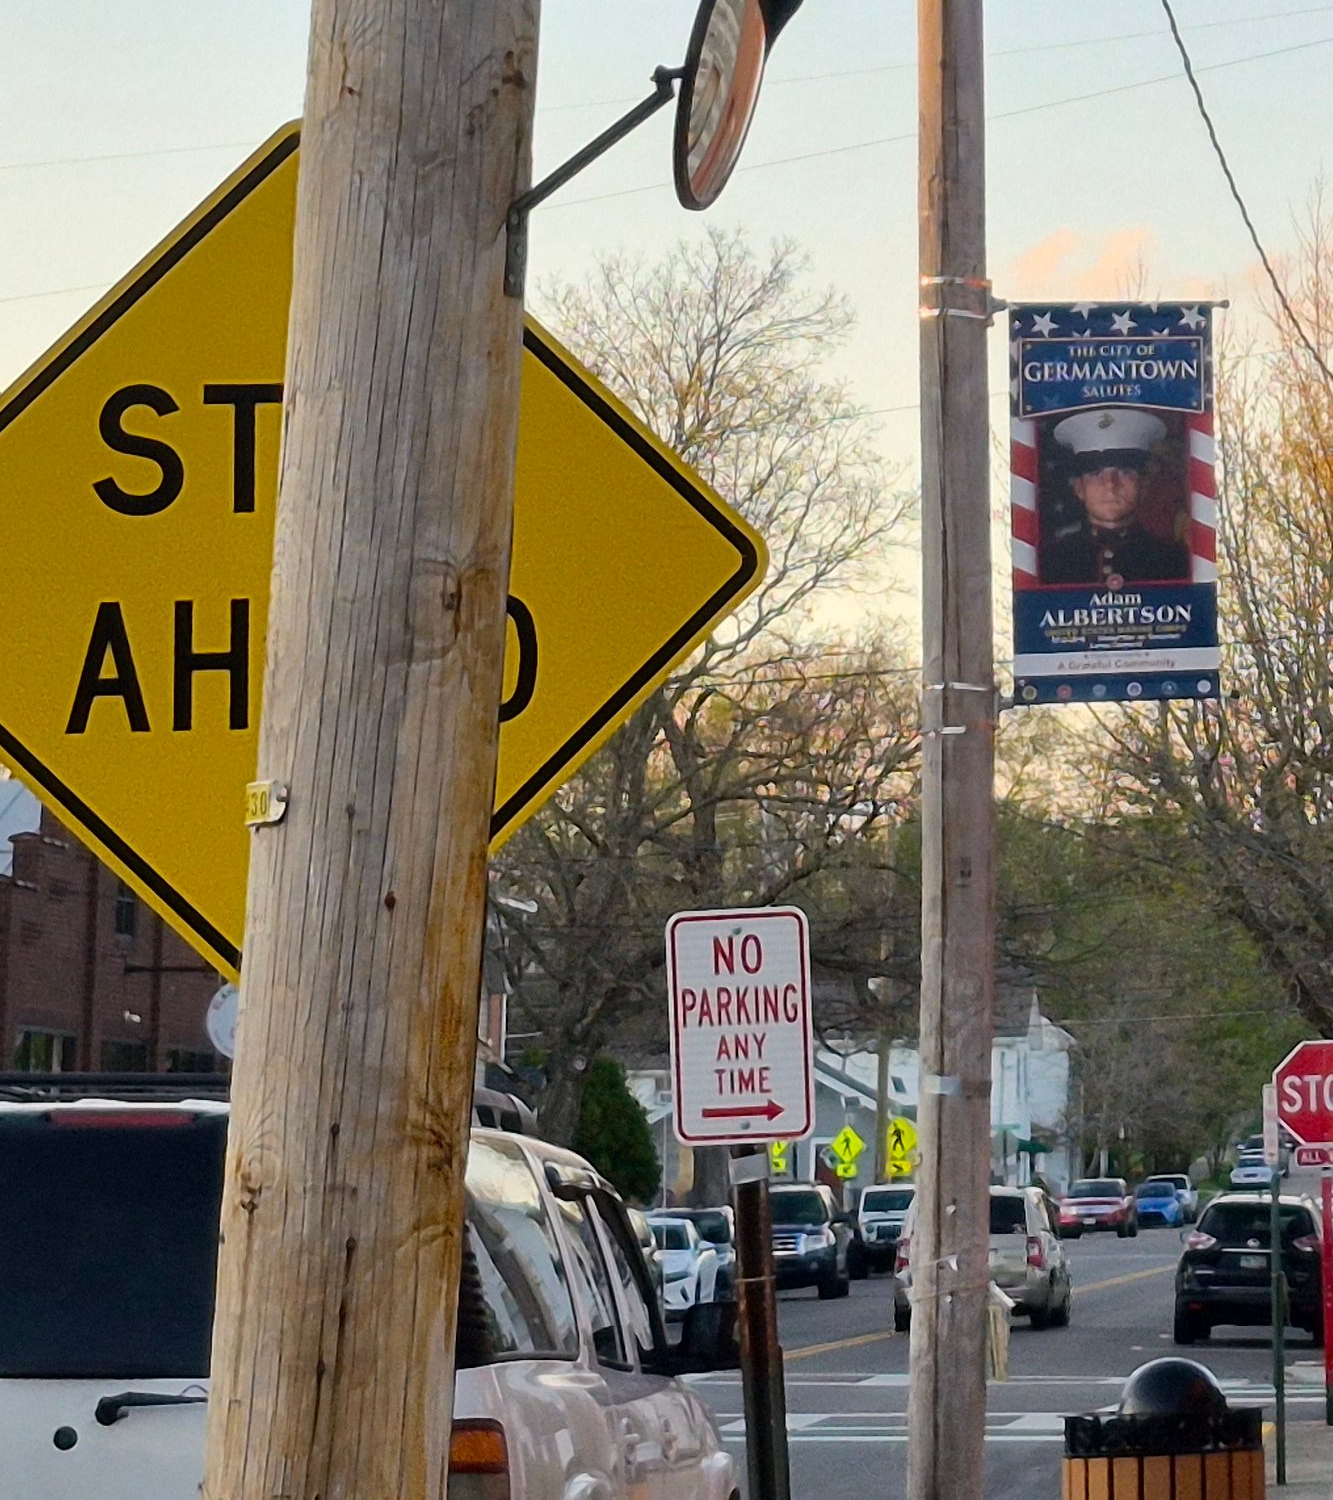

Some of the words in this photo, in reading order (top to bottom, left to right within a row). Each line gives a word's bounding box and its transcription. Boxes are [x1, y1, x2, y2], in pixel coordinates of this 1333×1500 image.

[1100, 344, 1135, 358] CITY
[1023, 358, 1199, 383] GERMANTOWN
[1082, 383, 1142, 399] SALUTES
[91, 382, 286, 517] ST
[1089, 590, 1142, 607] Adam
[1039, 603, 1193, 628] ALBERTSON
[712, 934, 763, 976] NO
[681, 983, 798, 1028] PARKING
[716, 1032, 767, 1062] ANY
[714, 1066, 773, 1096] TIME
[1301, 1150, 1323, 1164] ALL
